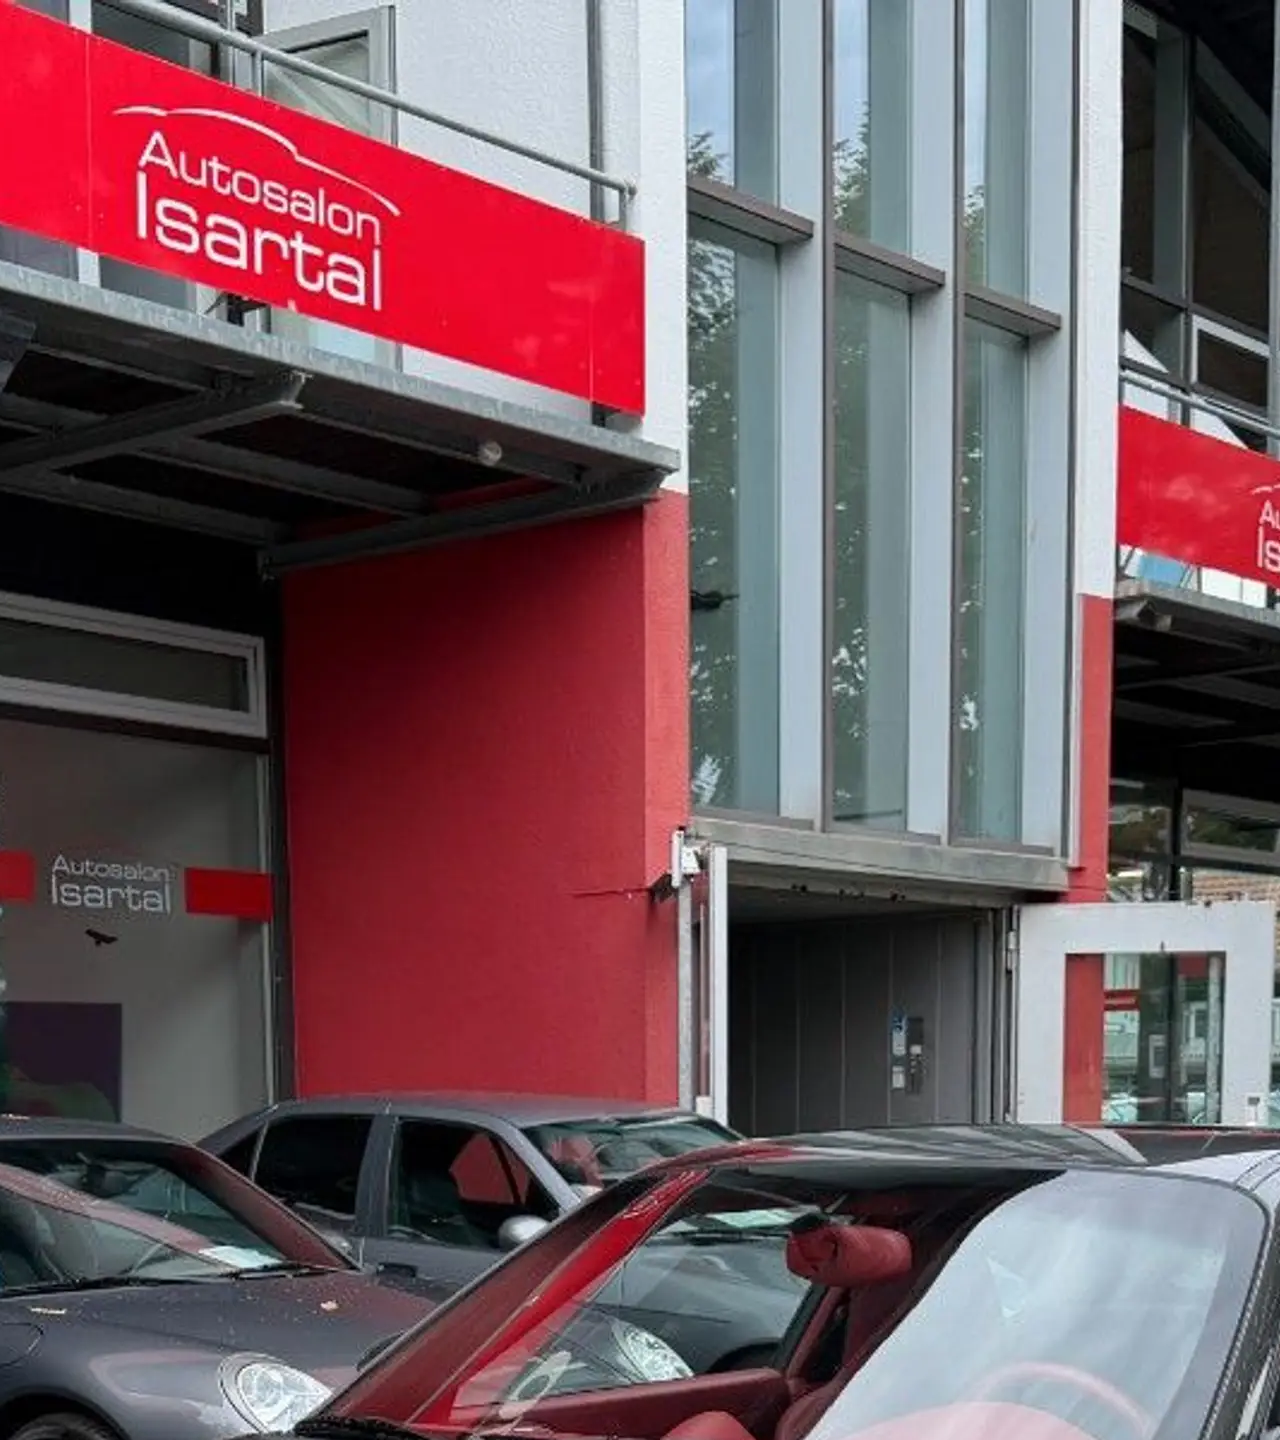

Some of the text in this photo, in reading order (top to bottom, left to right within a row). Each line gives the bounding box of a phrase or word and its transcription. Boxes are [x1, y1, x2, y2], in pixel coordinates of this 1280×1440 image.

[137, 129, 382, 246] Autosalon
[135, 170, 383, 311] Isartal
[51, 874, 171, 915] Isartal
[52, 853, 170, 882] Autosalon
